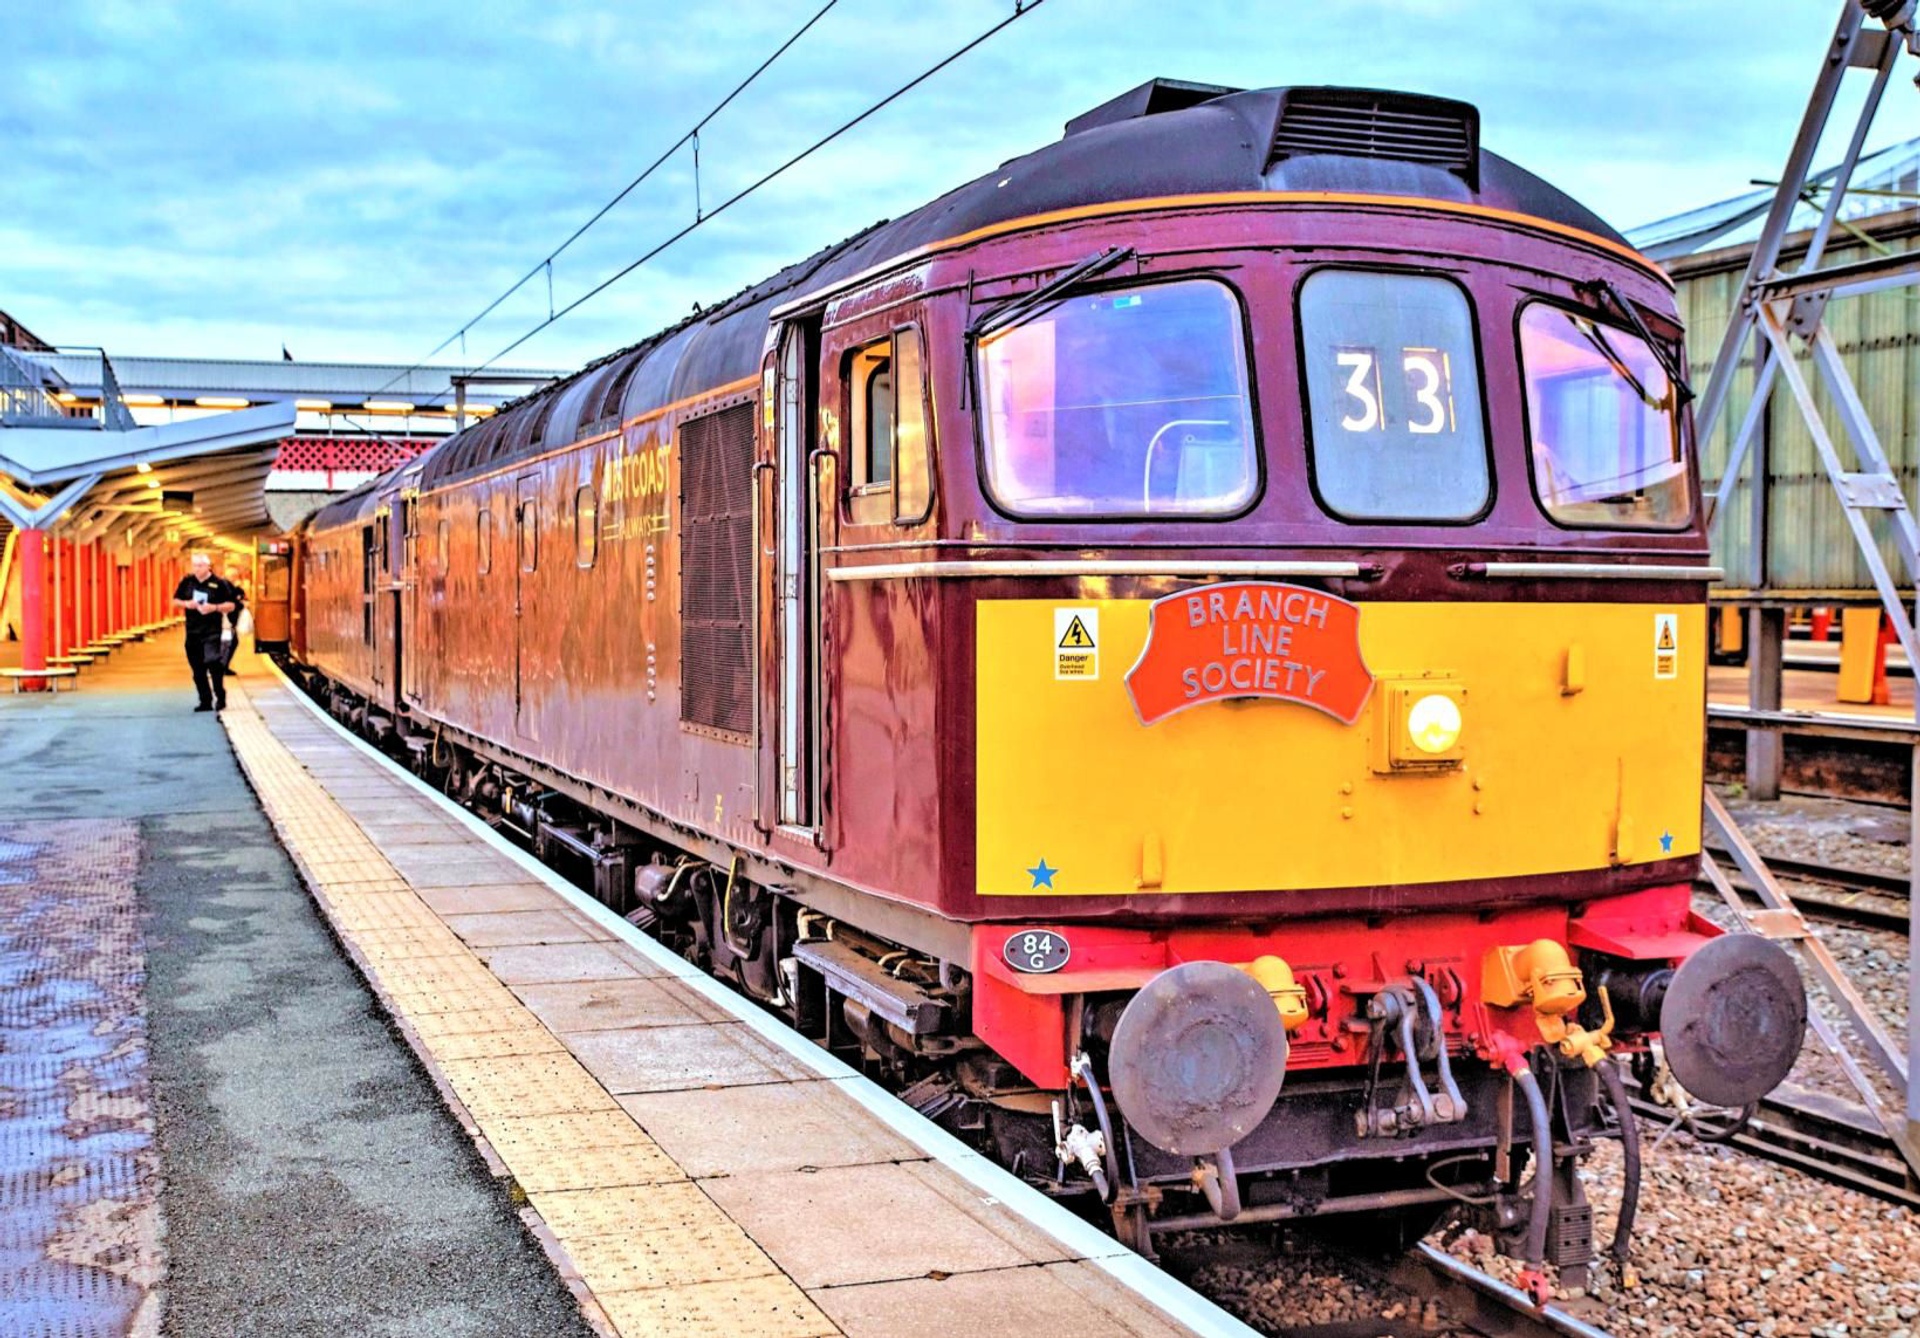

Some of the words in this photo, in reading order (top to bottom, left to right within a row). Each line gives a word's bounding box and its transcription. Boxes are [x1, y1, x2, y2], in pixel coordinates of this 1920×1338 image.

[1187, 590, 1329, 629] BRANCH
[1223, 624, 1293, 656] LINE
[1059, 654, 1088, 662] Danger
[1182, 658, 1326, 698] SOCIETY
[1023, 934, 1052, 955] 84
[1030, 953, 1044, 968] G
